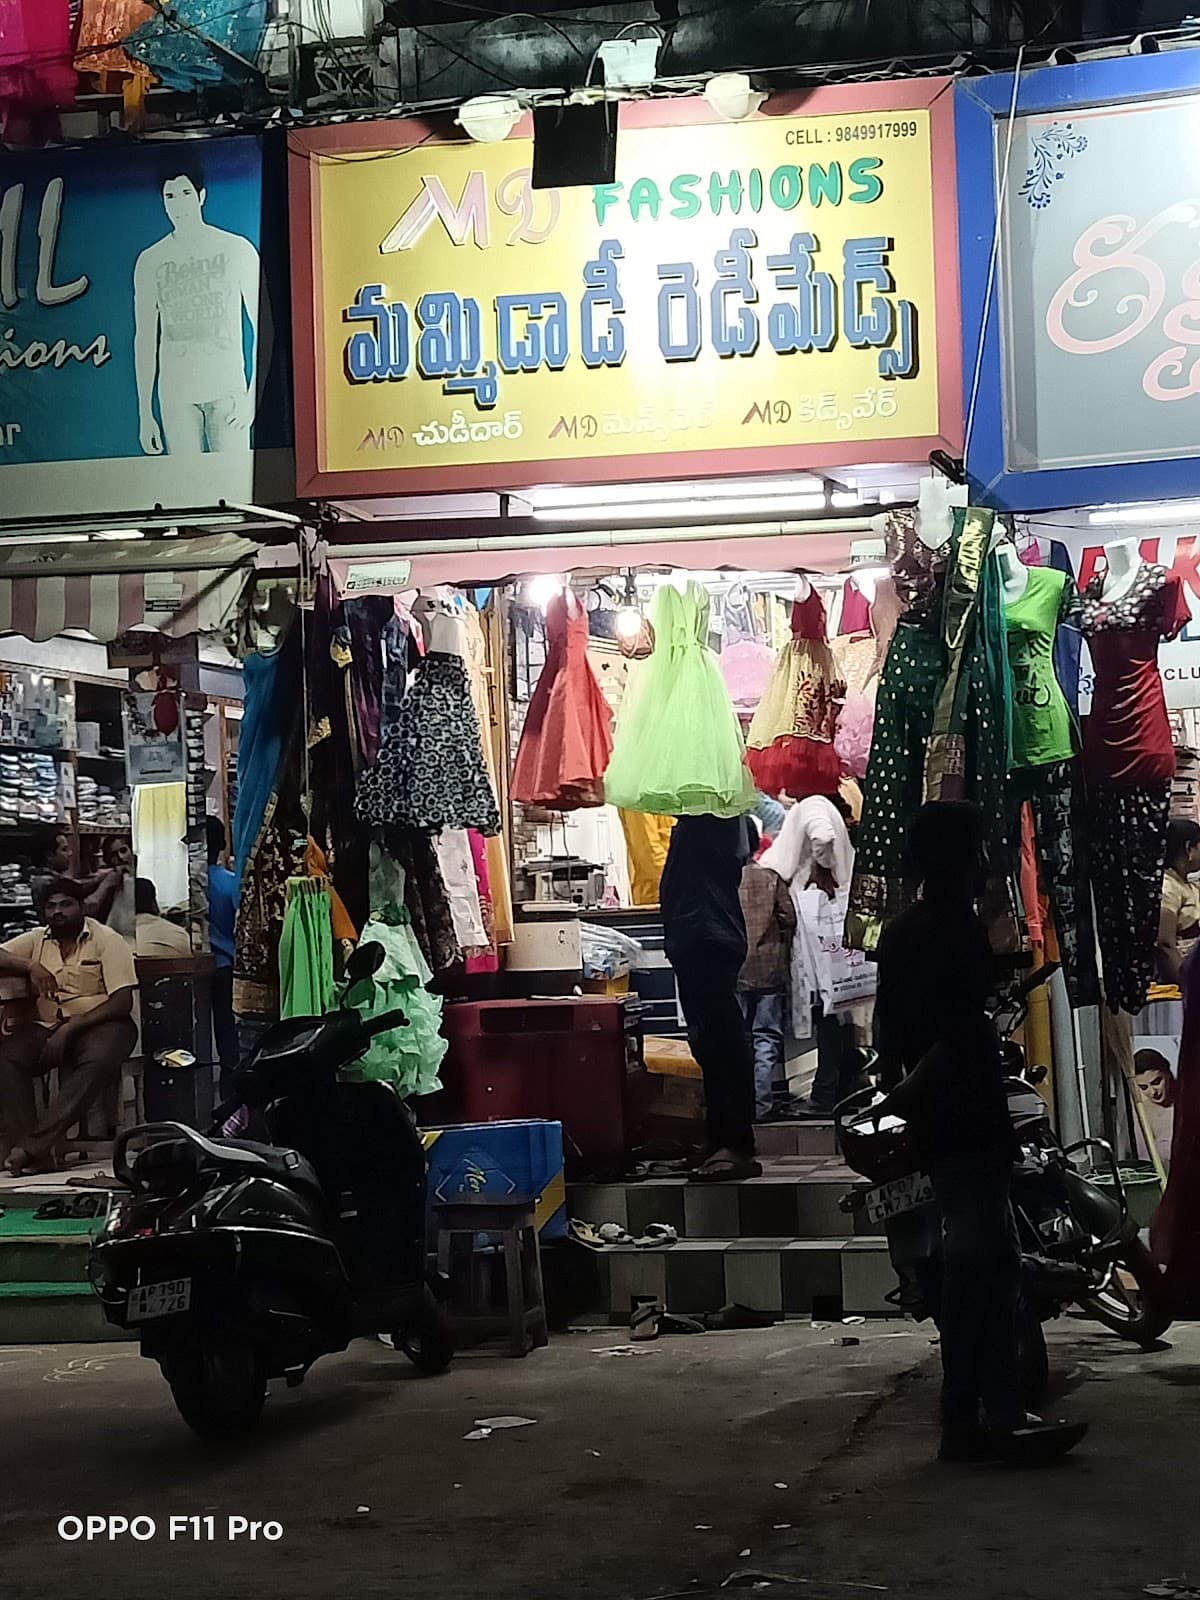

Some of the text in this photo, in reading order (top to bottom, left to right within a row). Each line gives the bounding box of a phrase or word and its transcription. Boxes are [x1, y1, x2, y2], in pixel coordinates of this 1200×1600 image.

[835, 121, 918, 143] 9849917999
[378, 156, 884, 255] MD FASHIONS
[342, 227, 920, 411] మమ్మిడాడీ రెడీమేడ్స్
[357, 425, 405, 451] MD
[548, 414, 598, 439] MD
[741, 399, 792, 425] MD
